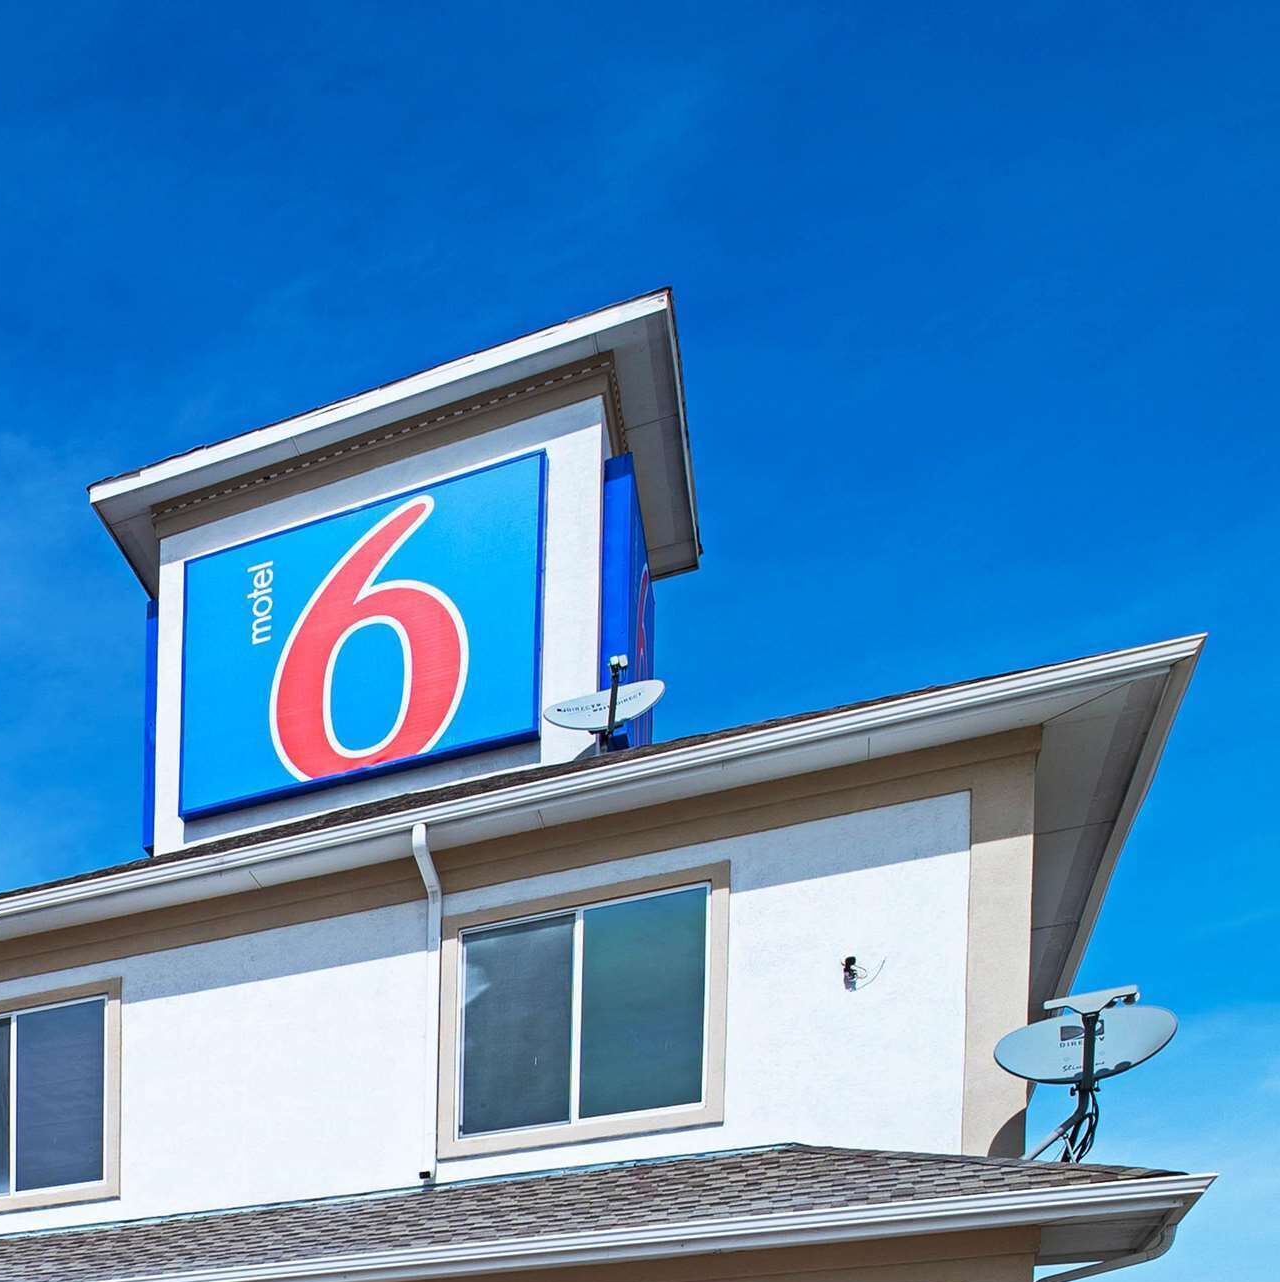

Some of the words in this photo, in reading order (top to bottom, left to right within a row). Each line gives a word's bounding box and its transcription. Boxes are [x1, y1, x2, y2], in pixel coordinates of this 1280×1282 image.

[247, 560, 274, 645] motel
[269, 494, 469, 782] 6
[1059, 1036, 1105, 1048] DIREV
